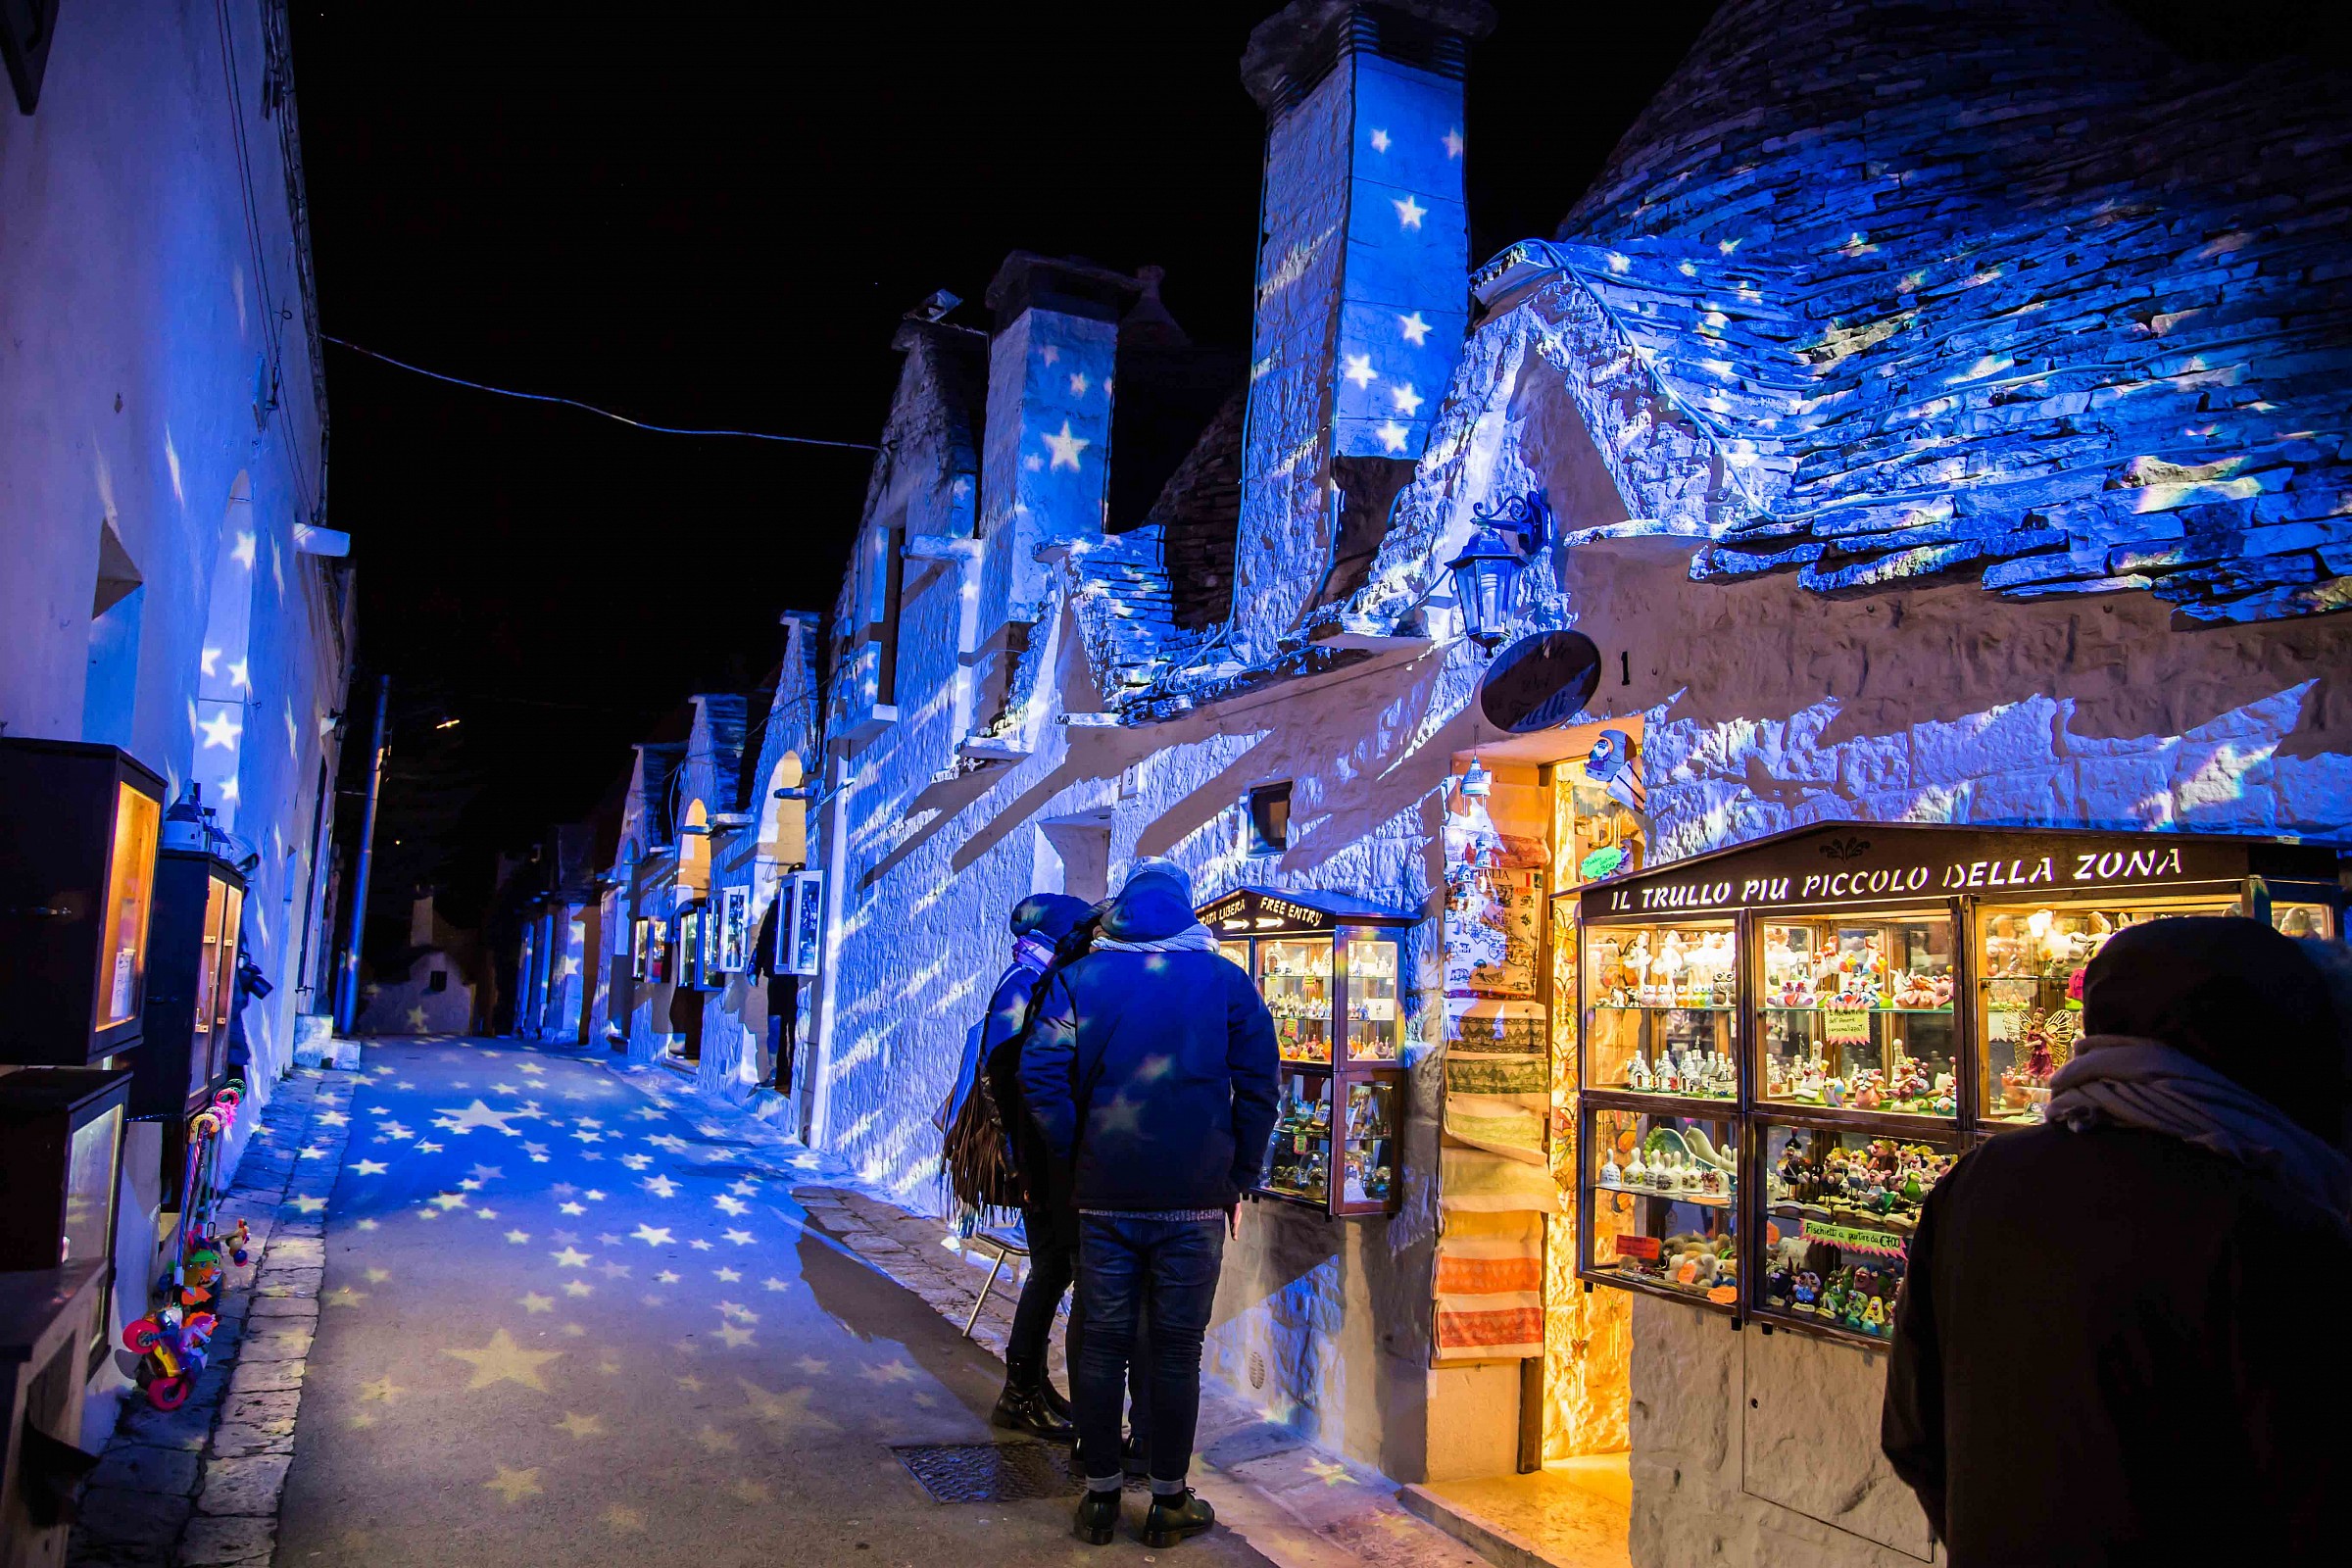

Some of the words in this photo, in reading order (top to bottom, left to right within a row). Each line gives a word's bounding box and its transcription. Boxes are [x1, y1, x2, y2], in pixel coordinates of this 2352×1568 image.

[1610, 890, 1632, 911] IL
[1642, 881, 1732, 909] TRULLO
[1740, 876, 1790, 903] PIU
[1801, 865, 1930, 899] PICCOLO
[1941, 857, 2055, 889] DELLA
[2072, 848, 2182, 880] ZONA
[1198, 910, 1217, 926] RATA
[1218, 898, 1246, 921] LIBERA
[1259, 896, 1287, 915] FREE
[1287, 903, 1323, 927] ENTRY
[1806, 1222, 1838, 1237] Fischietti
[1848, 1231, 1870, 1243] partire
[1870, 1235, 1880, 1244] da
